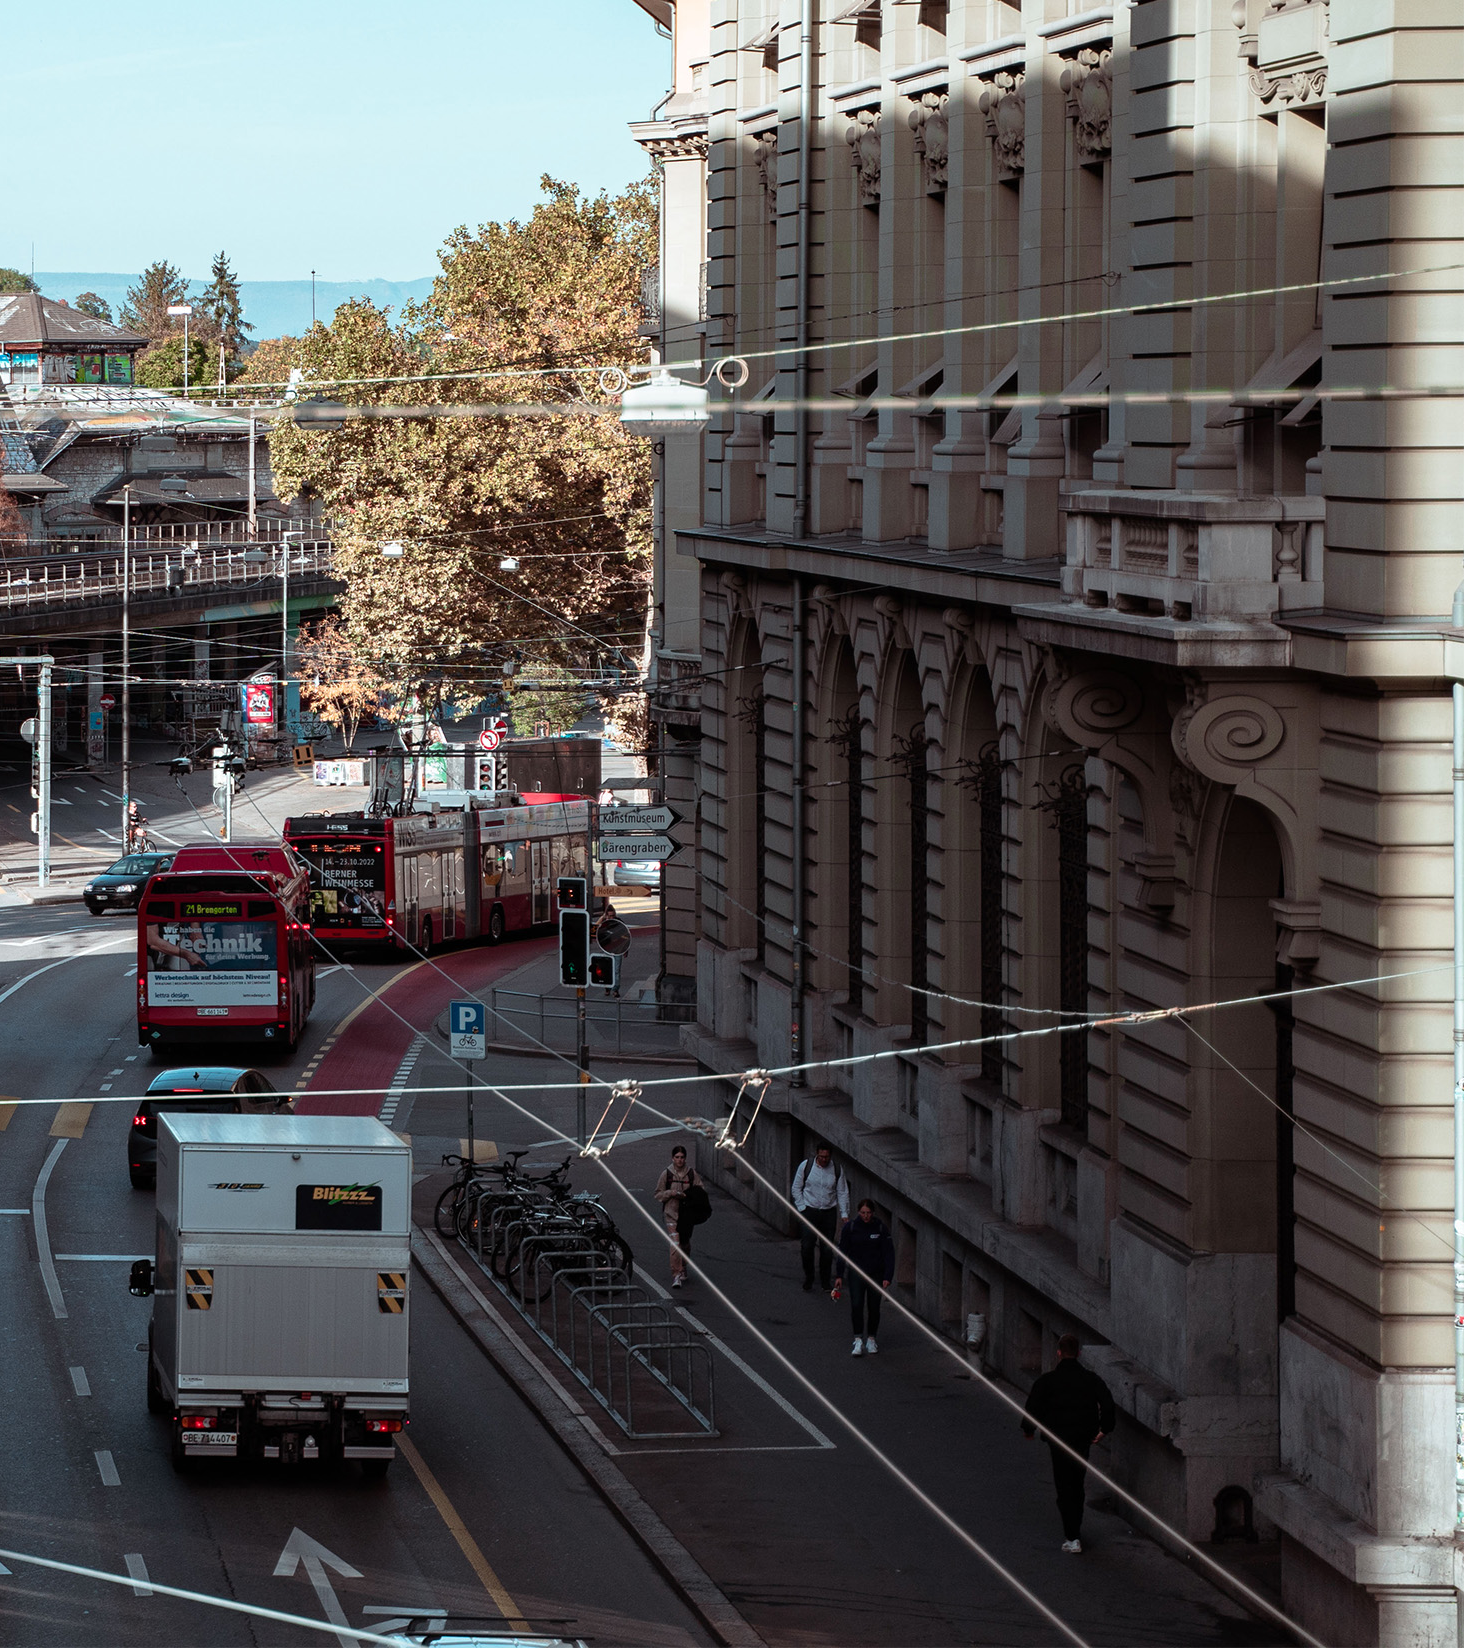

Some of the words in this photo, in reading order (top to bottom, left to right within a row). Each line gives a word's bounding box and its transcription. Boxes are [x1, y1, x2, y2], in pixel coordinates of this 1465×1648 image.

[602, 814, 665, 823] Kunstmuseum
[325, 869, 357, 878] BERNER
[325, 879, 374, 888] WEINMESSE
[186, 904, 195, 914] 21
[163, 933, 263, 953] Technik
[237, 953, 270, 961] Werbung.
[459, 1006, 477, 1030] P
[313, 1187, 376, 1200] Blitzzz
